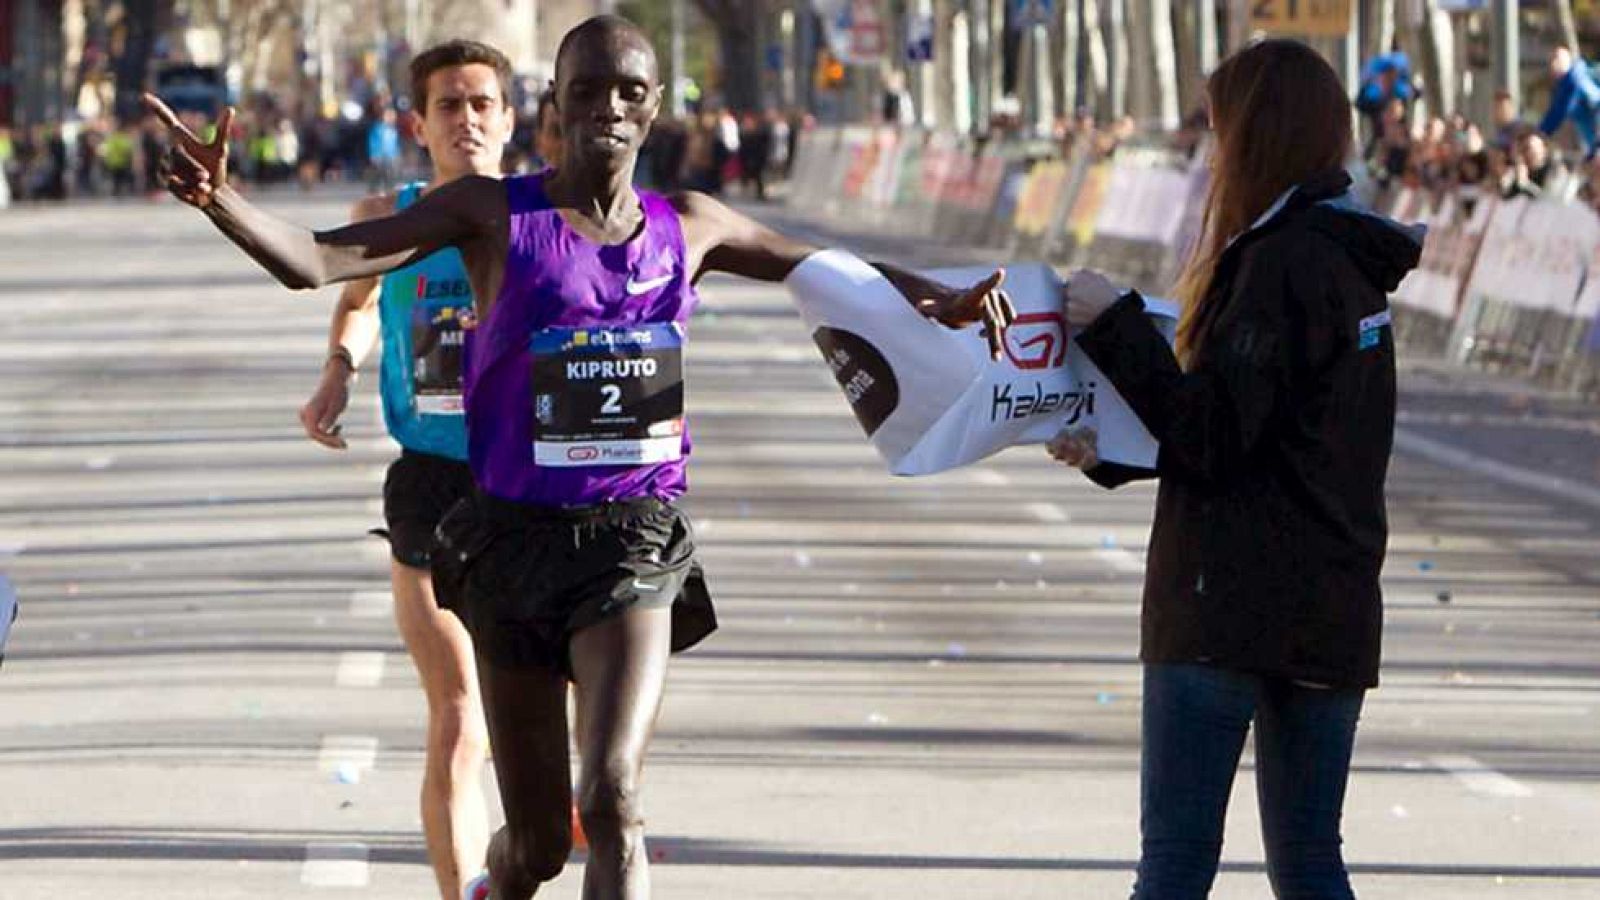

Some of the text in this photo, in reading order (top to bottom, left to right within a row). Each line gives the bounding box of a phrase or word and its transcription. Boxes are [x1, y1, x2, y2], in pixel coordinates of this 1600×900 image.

[566, 357, 658, 380] KIPRUTO
[600, 384, 622, 414] 2
[991, 380, 1097, 425] Kalenji
